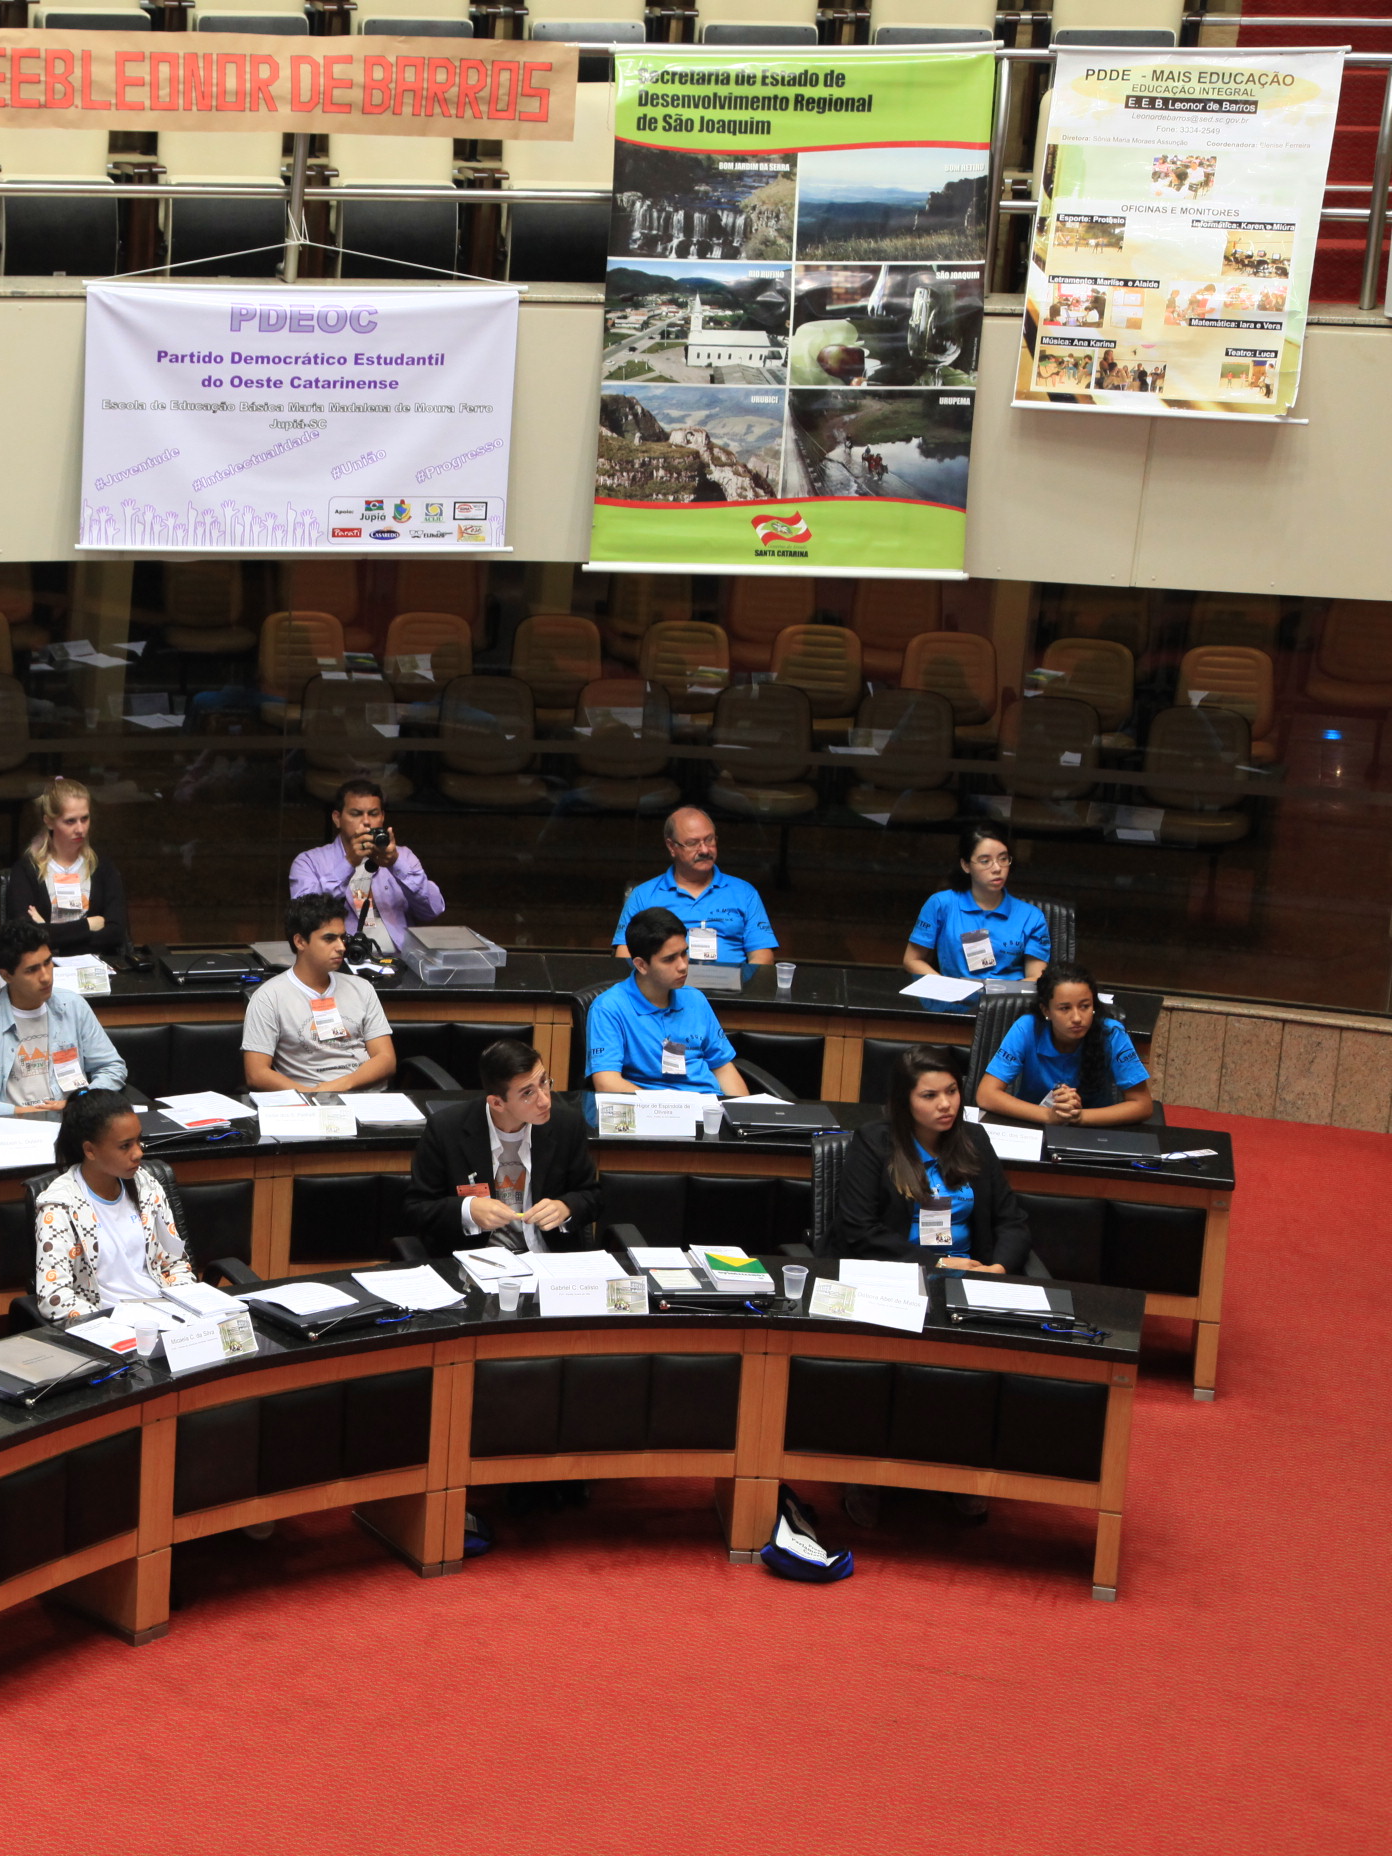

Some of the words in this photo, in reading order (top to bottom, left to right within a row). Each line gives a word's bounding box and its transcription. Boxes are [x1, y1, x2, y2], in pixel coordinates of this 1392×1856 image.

[638, 67, 730, 86] Secretaria
[734, 69, 757, 87] de
[760, 69, 820, 88] Estado
[823, 69, 846, 88] de
[1084, 68, 1132, 82] PDDE
[1151, 69, 1193, 84] MAIS
[1197, 70, 1296, 88] EDUCAÇÃO
[290, 55, 353, 114] DE
[361, 55, 553, 122] BARROS
[1131, 83, 1196, 96] EDUCAÇÃO
[1198, 86, 1256, 97] INTEGRAL
[638, 90, 790, 112] Desenvolvimento
[793, 93, 873, 115] Regional
[1168, 99, 1205, 111] Leonor
[1206, 100, 1220, 112] de
[1221, 101, 1256, 113] Barros
[636, 113, 658, 132] de
[662, 112, 695, 134] São
[697, 115, 772, 136] Joaquim
[719, 162, 734, 171] BOM
[734, 162, 759, 171] JARDIM
[759, 163, 769, 171] DA
[769, 162, 790, 172] SERRA
[1120, 204, 1168, 214] OFICINAS
[1170, 206, 1177, 215] E
[1179, 207, 1240, 218] MONITORES
[1059, 214, 1092, 224] Esporte:
[935, 270, 949, 280] SÃO
[950, 271, 980, 281] JOAQUIM
[1049, 276, 1096, 286] Letramento:
[229, 302, 379, 335] PDEOC
[1191, 318, 1239, 329] Matemática:
[1262, 320, 1282, 331] Vera
[1041, 337, 1073, 347] Música:
[1072, 339, 1089, 347] Ana
[1090, 339, 1116, 349] Karina
[156, 350, 224, 366] Partido
[230, 350, 348, 367] Democrático
[353, 352, 445, 367] Estudantil
[1227, 348, 1255, 358] Teatro:
[1256, 350, 1276, 359] Luca
[201, 374, 224, 389] do
[229, 375, 284, 390] Oeste
[289, 376, 399, 391] Catarinense
[101, 399, 147, 411] Escola
[150, 400, 167, 411] de
[170, 399, 236, 414] Educação
[239, 401, 285, 412] Básica
[288, 402, 324, 413] Maria
[328, 402, 392, 413] Madalena
[394, 402, 411, 413] de
[414, 402, 456, 413] Moura
[458, 403, 494, 414] Ferro
[939, 396, 971, 406] URUPEMA
[191, 429, 320, 493] #Intelectualidade
[330, 448, 387, 481] #União
[414, 437, 504, 485] #Progresso
[94, 446, 181, 491] #Juventude
[360, 512, 387, 523] Jupiá
[754, 549, 776, 557] SANTA
[776, 550, 809, 558] CATARINA
